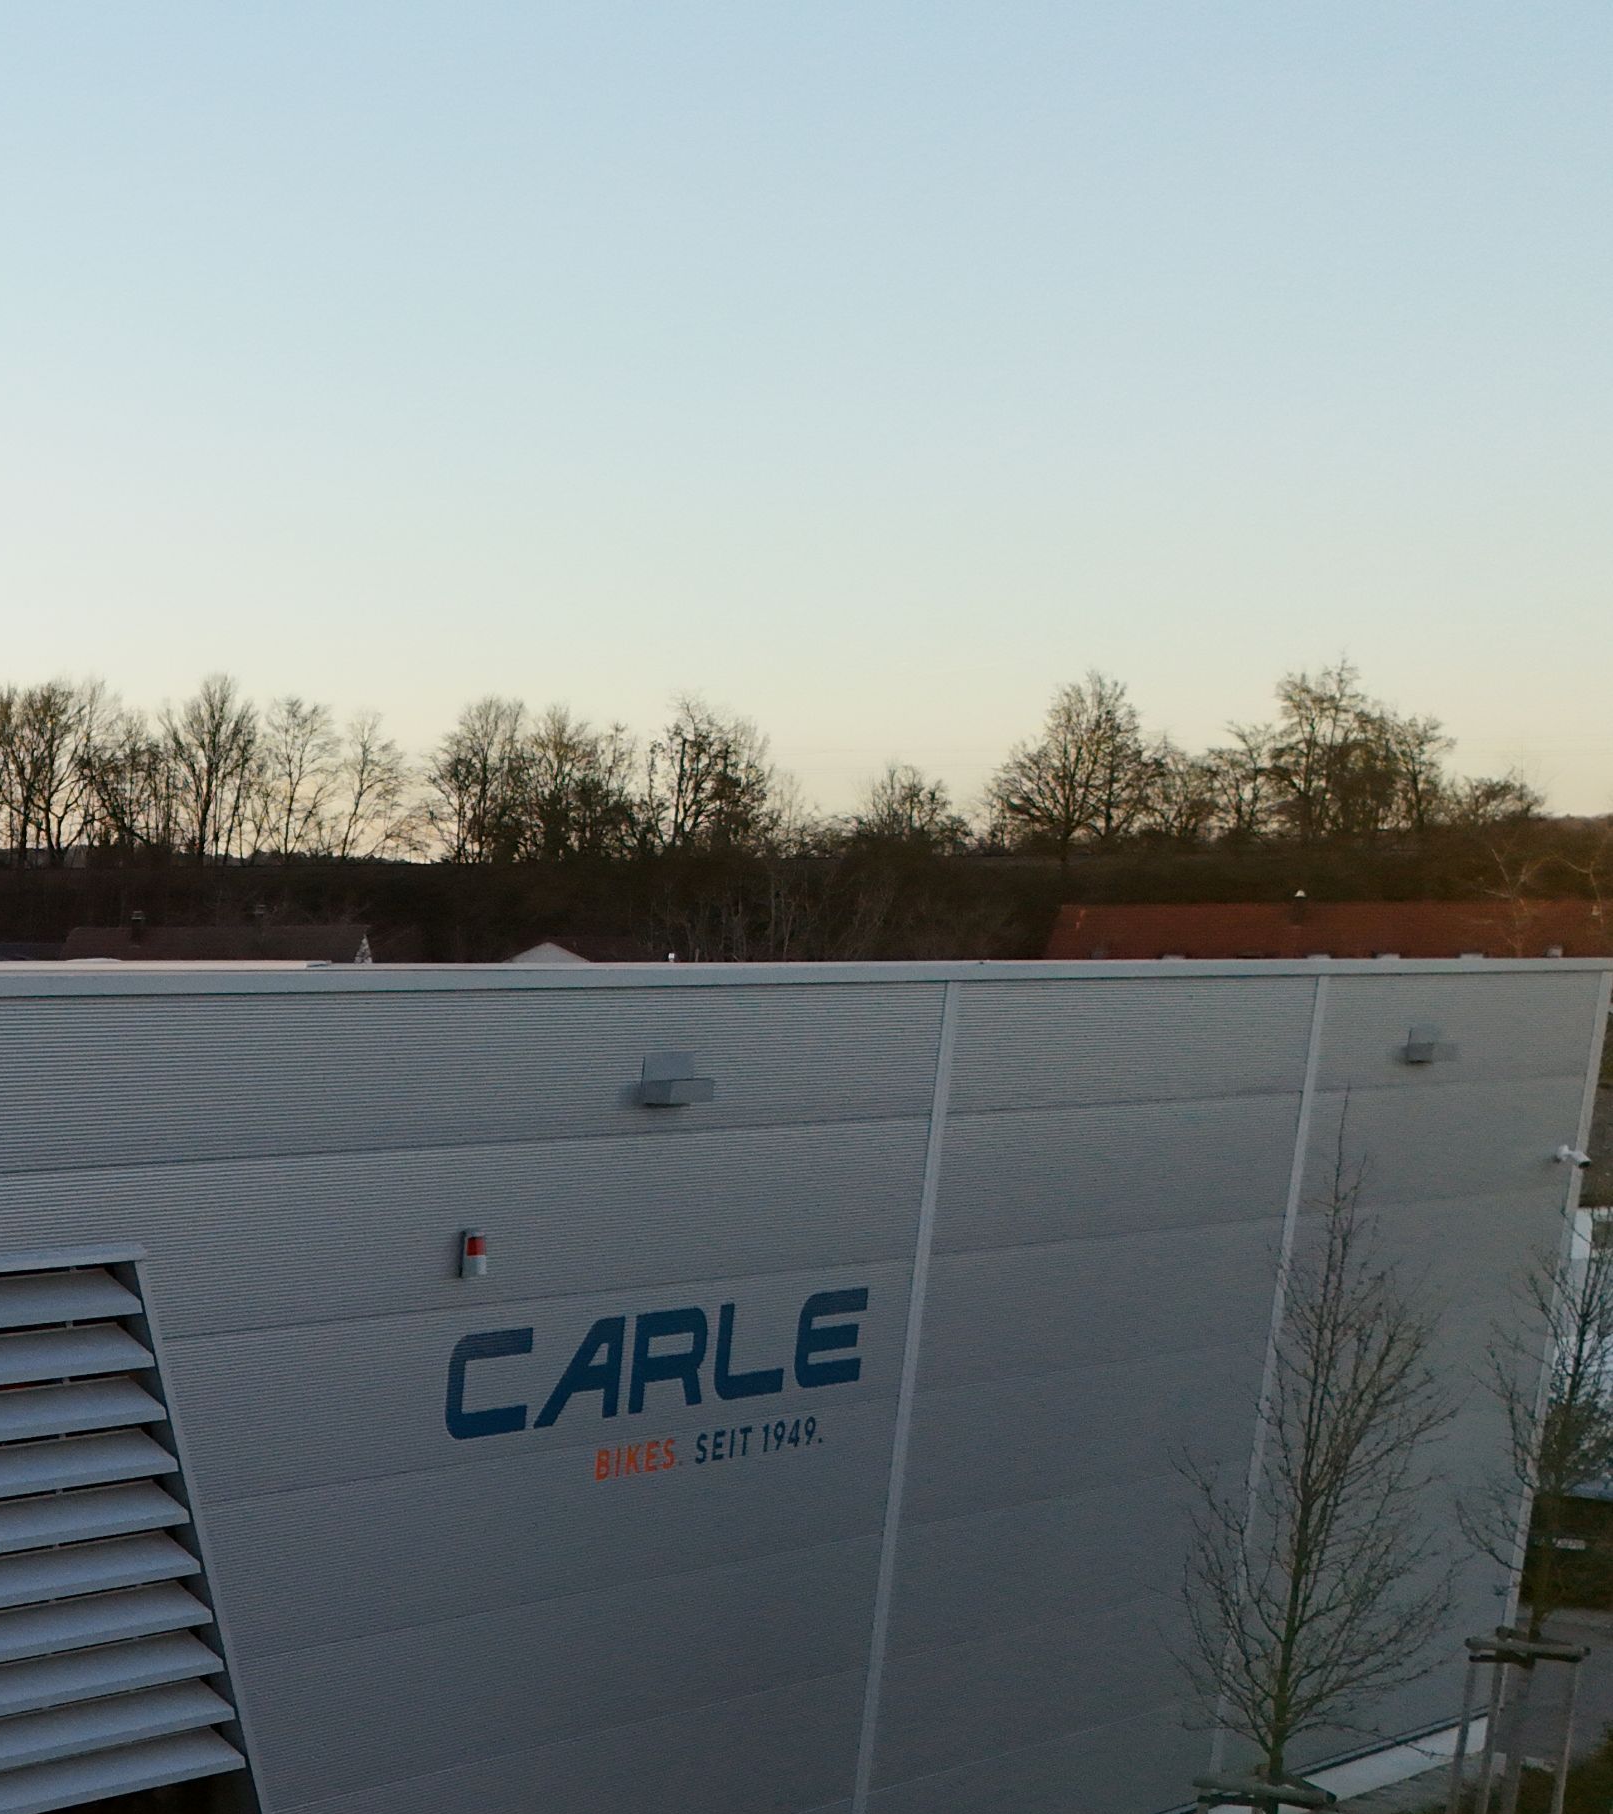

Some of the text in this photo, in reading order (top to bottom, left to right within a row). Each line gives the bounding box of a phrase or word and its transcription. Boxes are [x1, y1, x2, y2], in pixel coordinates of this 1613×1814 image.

[445, 1287, 868, 1440] CARLE
[695, 1425, 752, 1464] SEIT
[762, 1416, 823, 1453] 1949.
